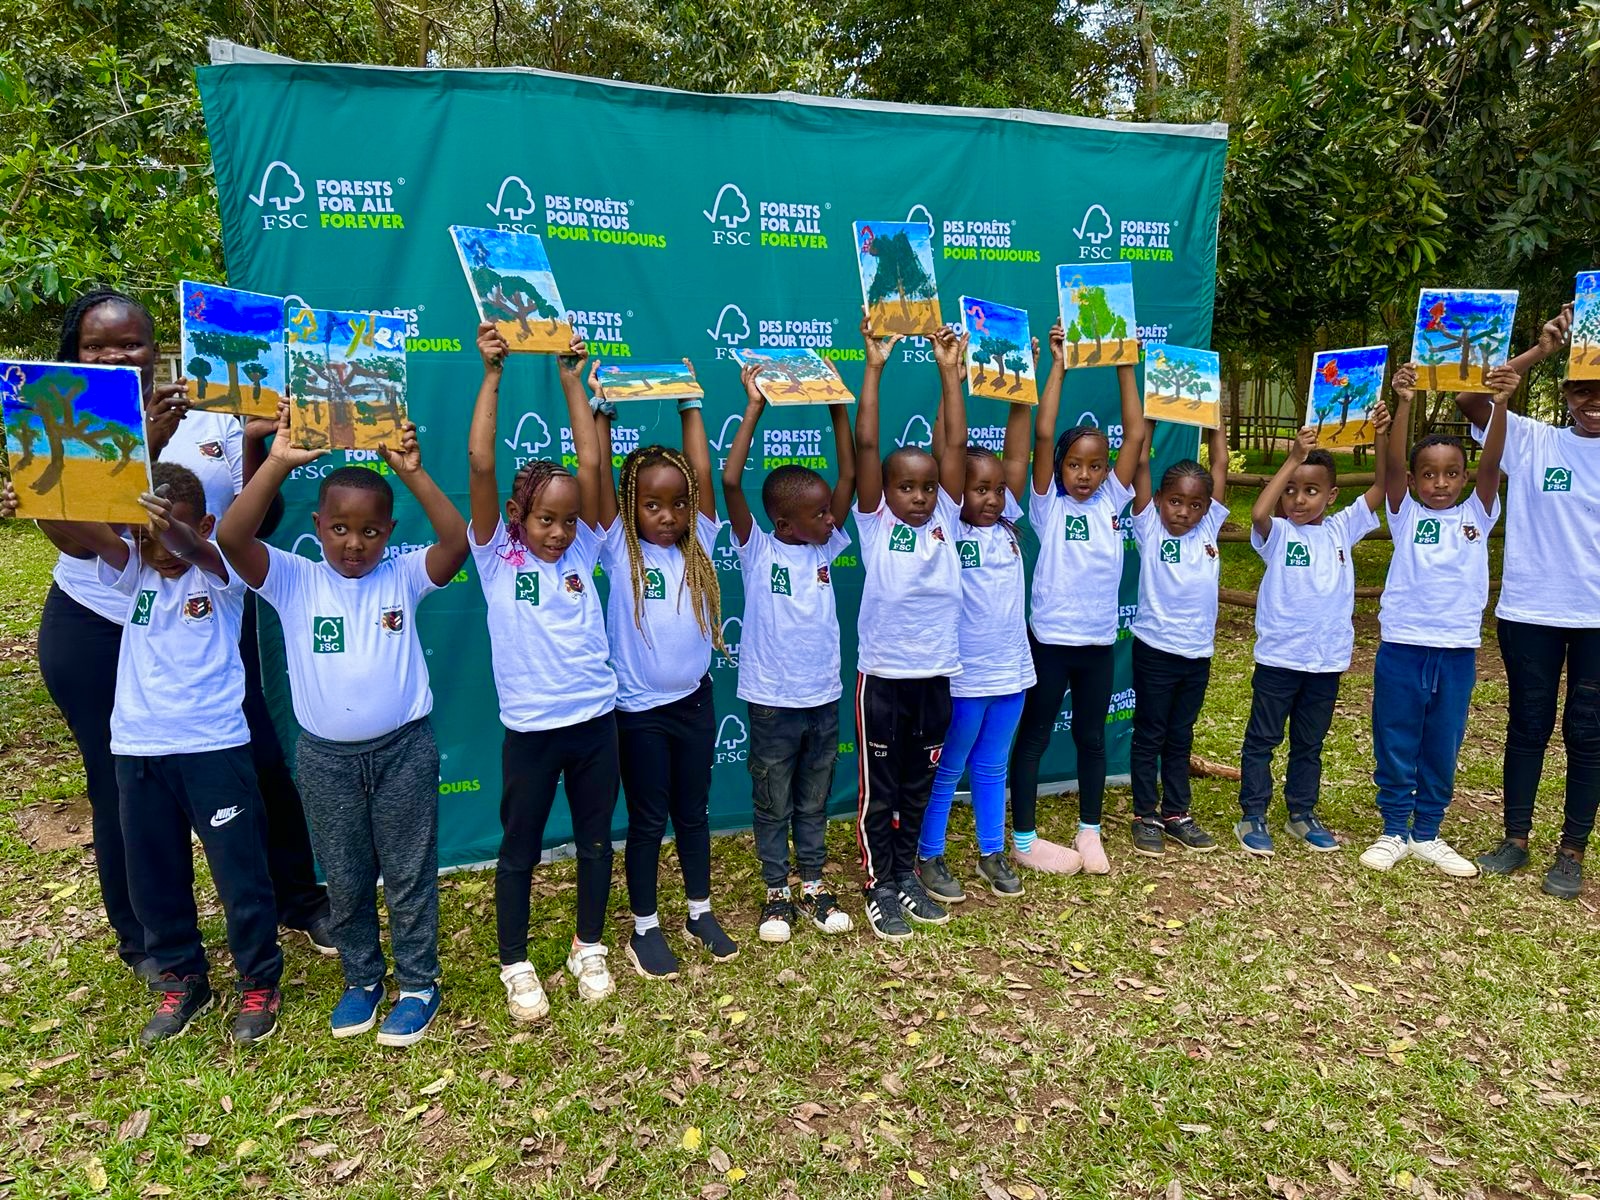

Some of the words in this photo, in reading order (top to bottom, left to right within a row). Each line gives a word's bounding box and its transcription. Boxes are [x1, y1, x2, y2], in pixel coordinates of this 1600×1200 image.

[316, 180, 393, 196] FORESTS
[318, 197, 356, 212] FOR
[362, 197, 394, 212] ALL
[545, 195, 571, 210] DES
[574, 197, 629, 215] FORÊTS
[760, 201, 821, 219] FORESTS
[261, 214, 308, 230] FSC
[320, 213, 405, 229] FOREVER
[546, 210, 589, 226] POUR
[590, 214, 630, 230] TOUS
[760, 217, 790, 233] FOR
[794, 219, 821, 234] ALL
[943, 220, 964, 234] DES
[967, 219, 1011, 235] FORÊTS
[1120, 220, 1170, 235] FORESTS
[547, 225, 590, 241] POUR
[591, 229, 667, 248] TOUJOURS
[712, 230, 751, 246] FSC
[761, 233, 828, 249] FOREVER
[943, 234, 978, 247] POUR
[979, 235, 1011, 248] TOUS
[1120, 234, 1145, 247] FOR
[1148, 235, 1169, 248] ALL
[943, 247, 978, 260] POUR
[979, 249, 1041, 263] TOUJOURS
[1078, 246, 1112, 259] FSC
[1119, 248, 1174, 262] FOREVER
[566, 310, 623, 327] ORESTS
[759, 320, 782, 333] DES
[785, 318, 833, 334] FORÊTS
[594, 327, 623, 342] ALL
[1136, 323, 1168, 338] ORÊTS
[404, 338, 462, 352] JOURS
[759, 334, 797, 347] POUR
[799, 335, 833, 348] TOUS
[586, 342, 632, 357] EVER
[715, 347, 735, 360] FS
[815, 348, 866, 361] JOURS
[611, 426, 640, 441] RÊTS
[763, 429, 822, 442] FORESTS
[763, 443, 792, 456] FOR
[796, 444, 821, 456] ALL
[763, 456, 828, 470] FOREVER
[1070, 532, 1086, 540] FSC
[892, 543, 911, 551] FSC
[319, 643, 340, 652] FSC
[715, 657, 739, 669] FS
[1054, 722, 1072, 732] FS
[715, 750, 747, 764] FSC
[215, 805, 238, 820] NIKE
